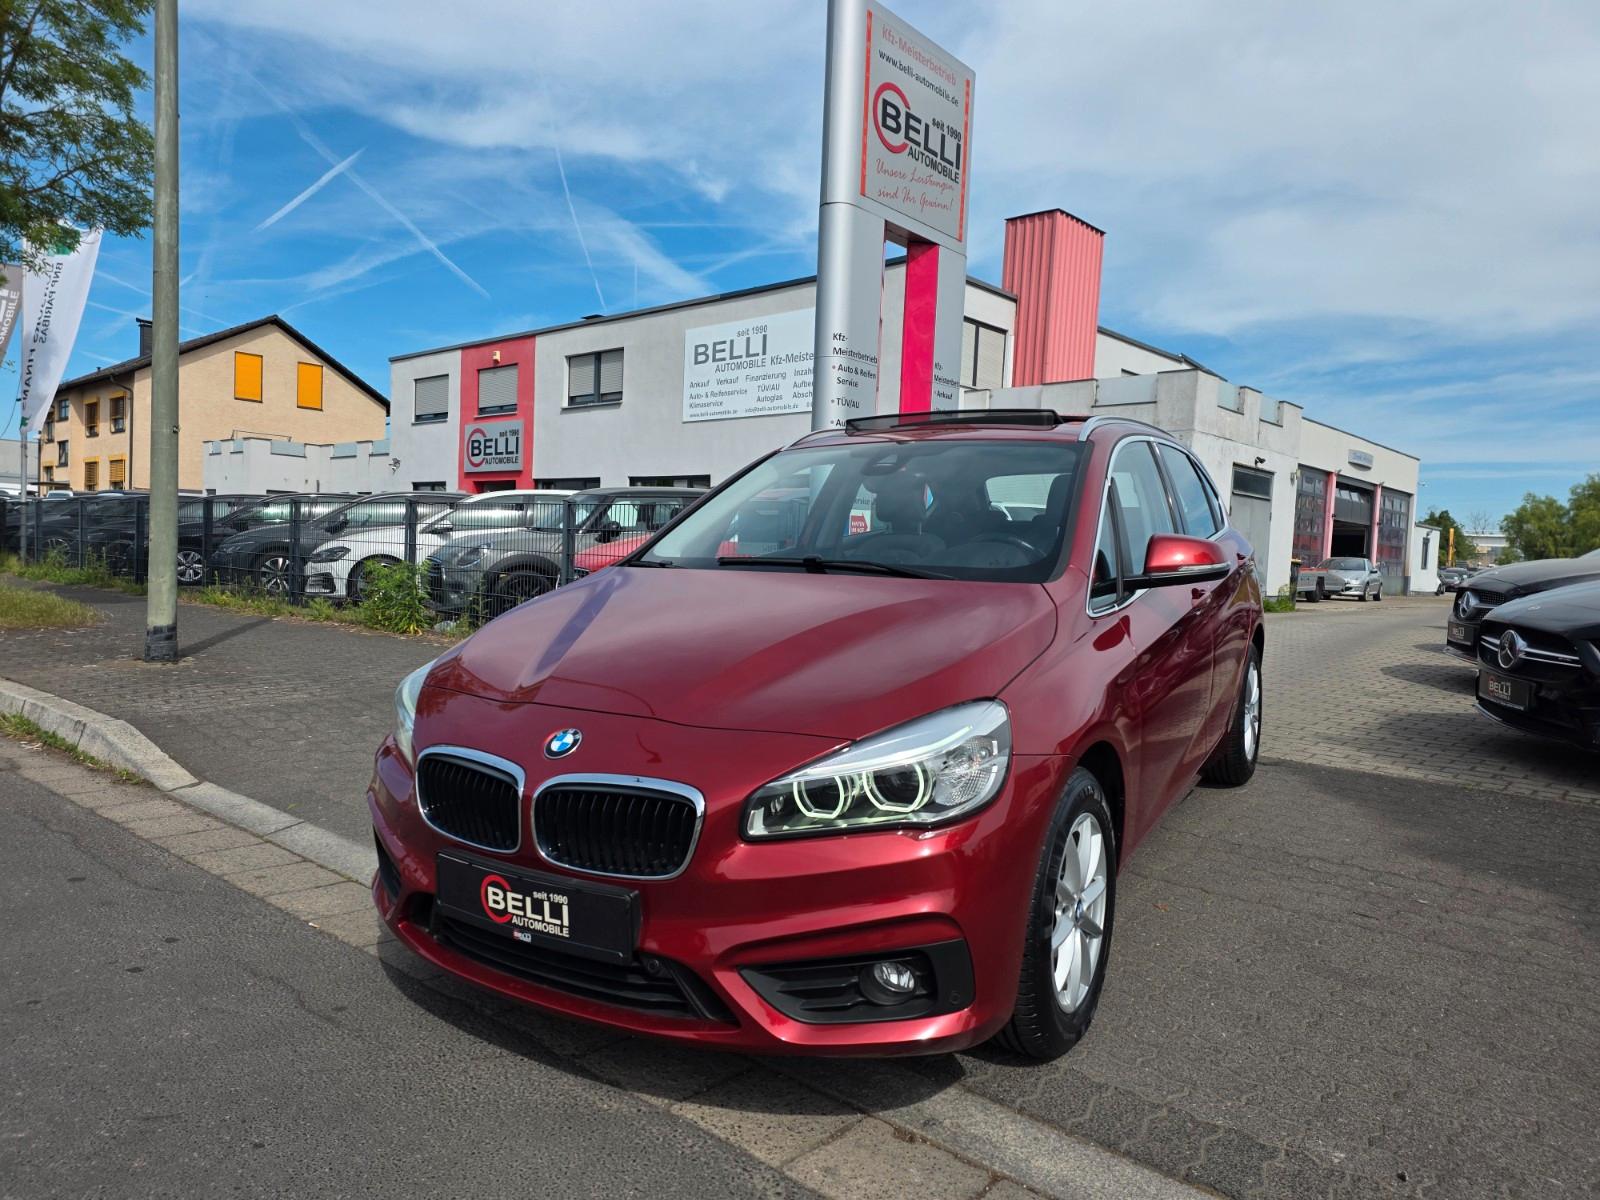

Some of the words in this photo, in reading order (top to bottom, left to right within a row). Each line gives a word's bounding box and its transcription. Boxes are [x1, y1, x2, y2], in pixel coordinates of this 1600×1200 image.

[882, 24, 957, 86] Kfz-Meisterbetrieb
[878, 49, 959, 107] www.belli-automobile.de
[881, 97, 961, 171] BELLI
[932, 118, 945, 133] seit
[946, 125, 962, 143] 1990
[907, 146, 960, 184] AUTOMOBILE
[878, 186, 899, 199] sind
[919, 192, 954, 213] Gewinn!
[737, 328, 750, 337] seit
[751, 325, 768, 335] 1990
[832, 331, 848, 342] Kfz-
[694, 334, 767, 365] BELLI
[832, 347, 878, 364] Meisterbetrieb
[715, 358, 766, 373] AUTOMOBILE
[838, 364, 853, 374] Auto
[854, 367, 859, 376] &
[860, 368, 876, 380] Reifen
[689, 380, 710, 388] Ankauf
[716, 376, 739, 386] Verkauf
[745, 372, 787, 382] Finanzierung
[837, 377, 859, 387] Service
[756, 394, 783, 403] Autoglas
[837, 396, 860, 408] TÜV/AU
[471, 437, 520, 457] BELLI
[484, 456, 519, 465] AUTOMOBILE
[487, 886, 569, 927] BELLI
[532, 891, 548, 901] seit
[549, 893, 568, 905] 1990
[511, 914, 570, 938] AUTOMOBILE
